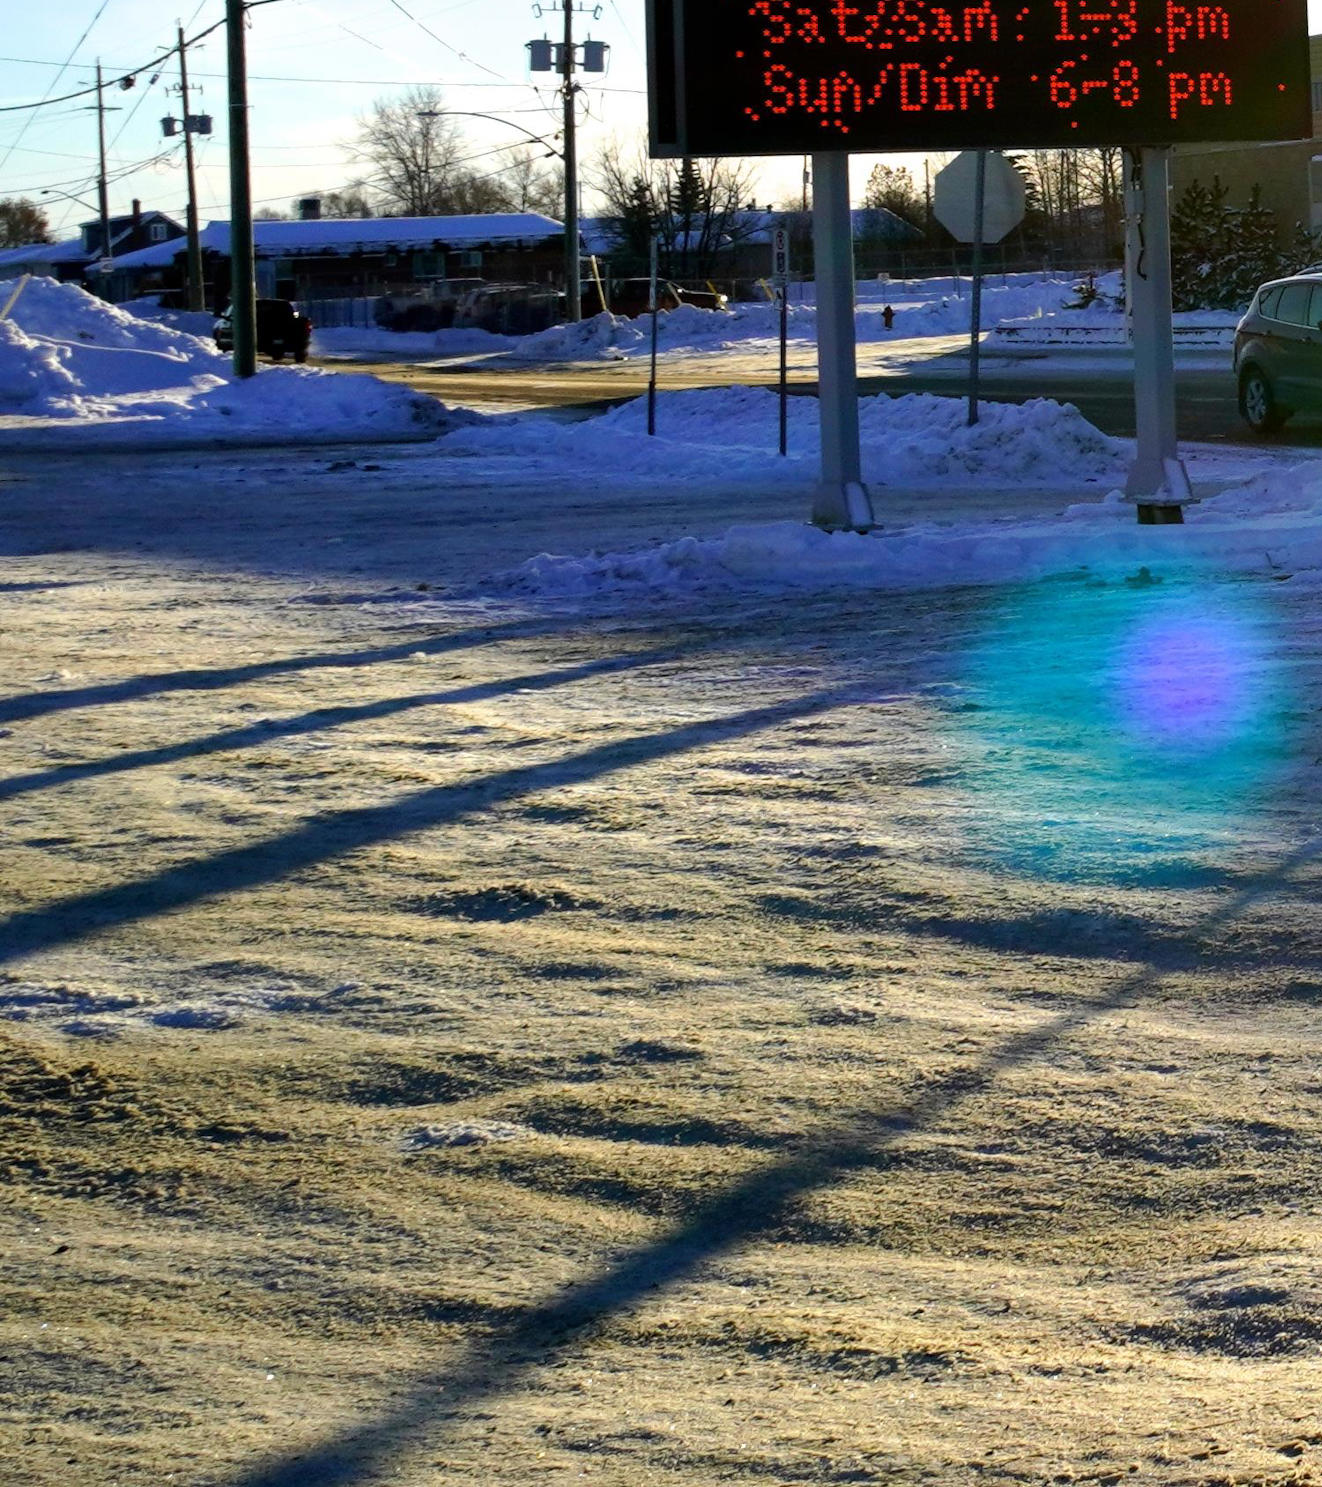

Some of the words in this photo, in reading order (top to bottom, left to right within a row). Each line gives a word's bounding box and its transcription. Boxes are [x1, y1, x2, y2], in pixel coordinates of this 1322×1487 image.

[1167, 1, 1231, 53] pm
[764, 63, 999, 114] Sun/Dim
[1050, 61, 1140, 108] 6-8
[1168, 72, 1233, 120] pm
